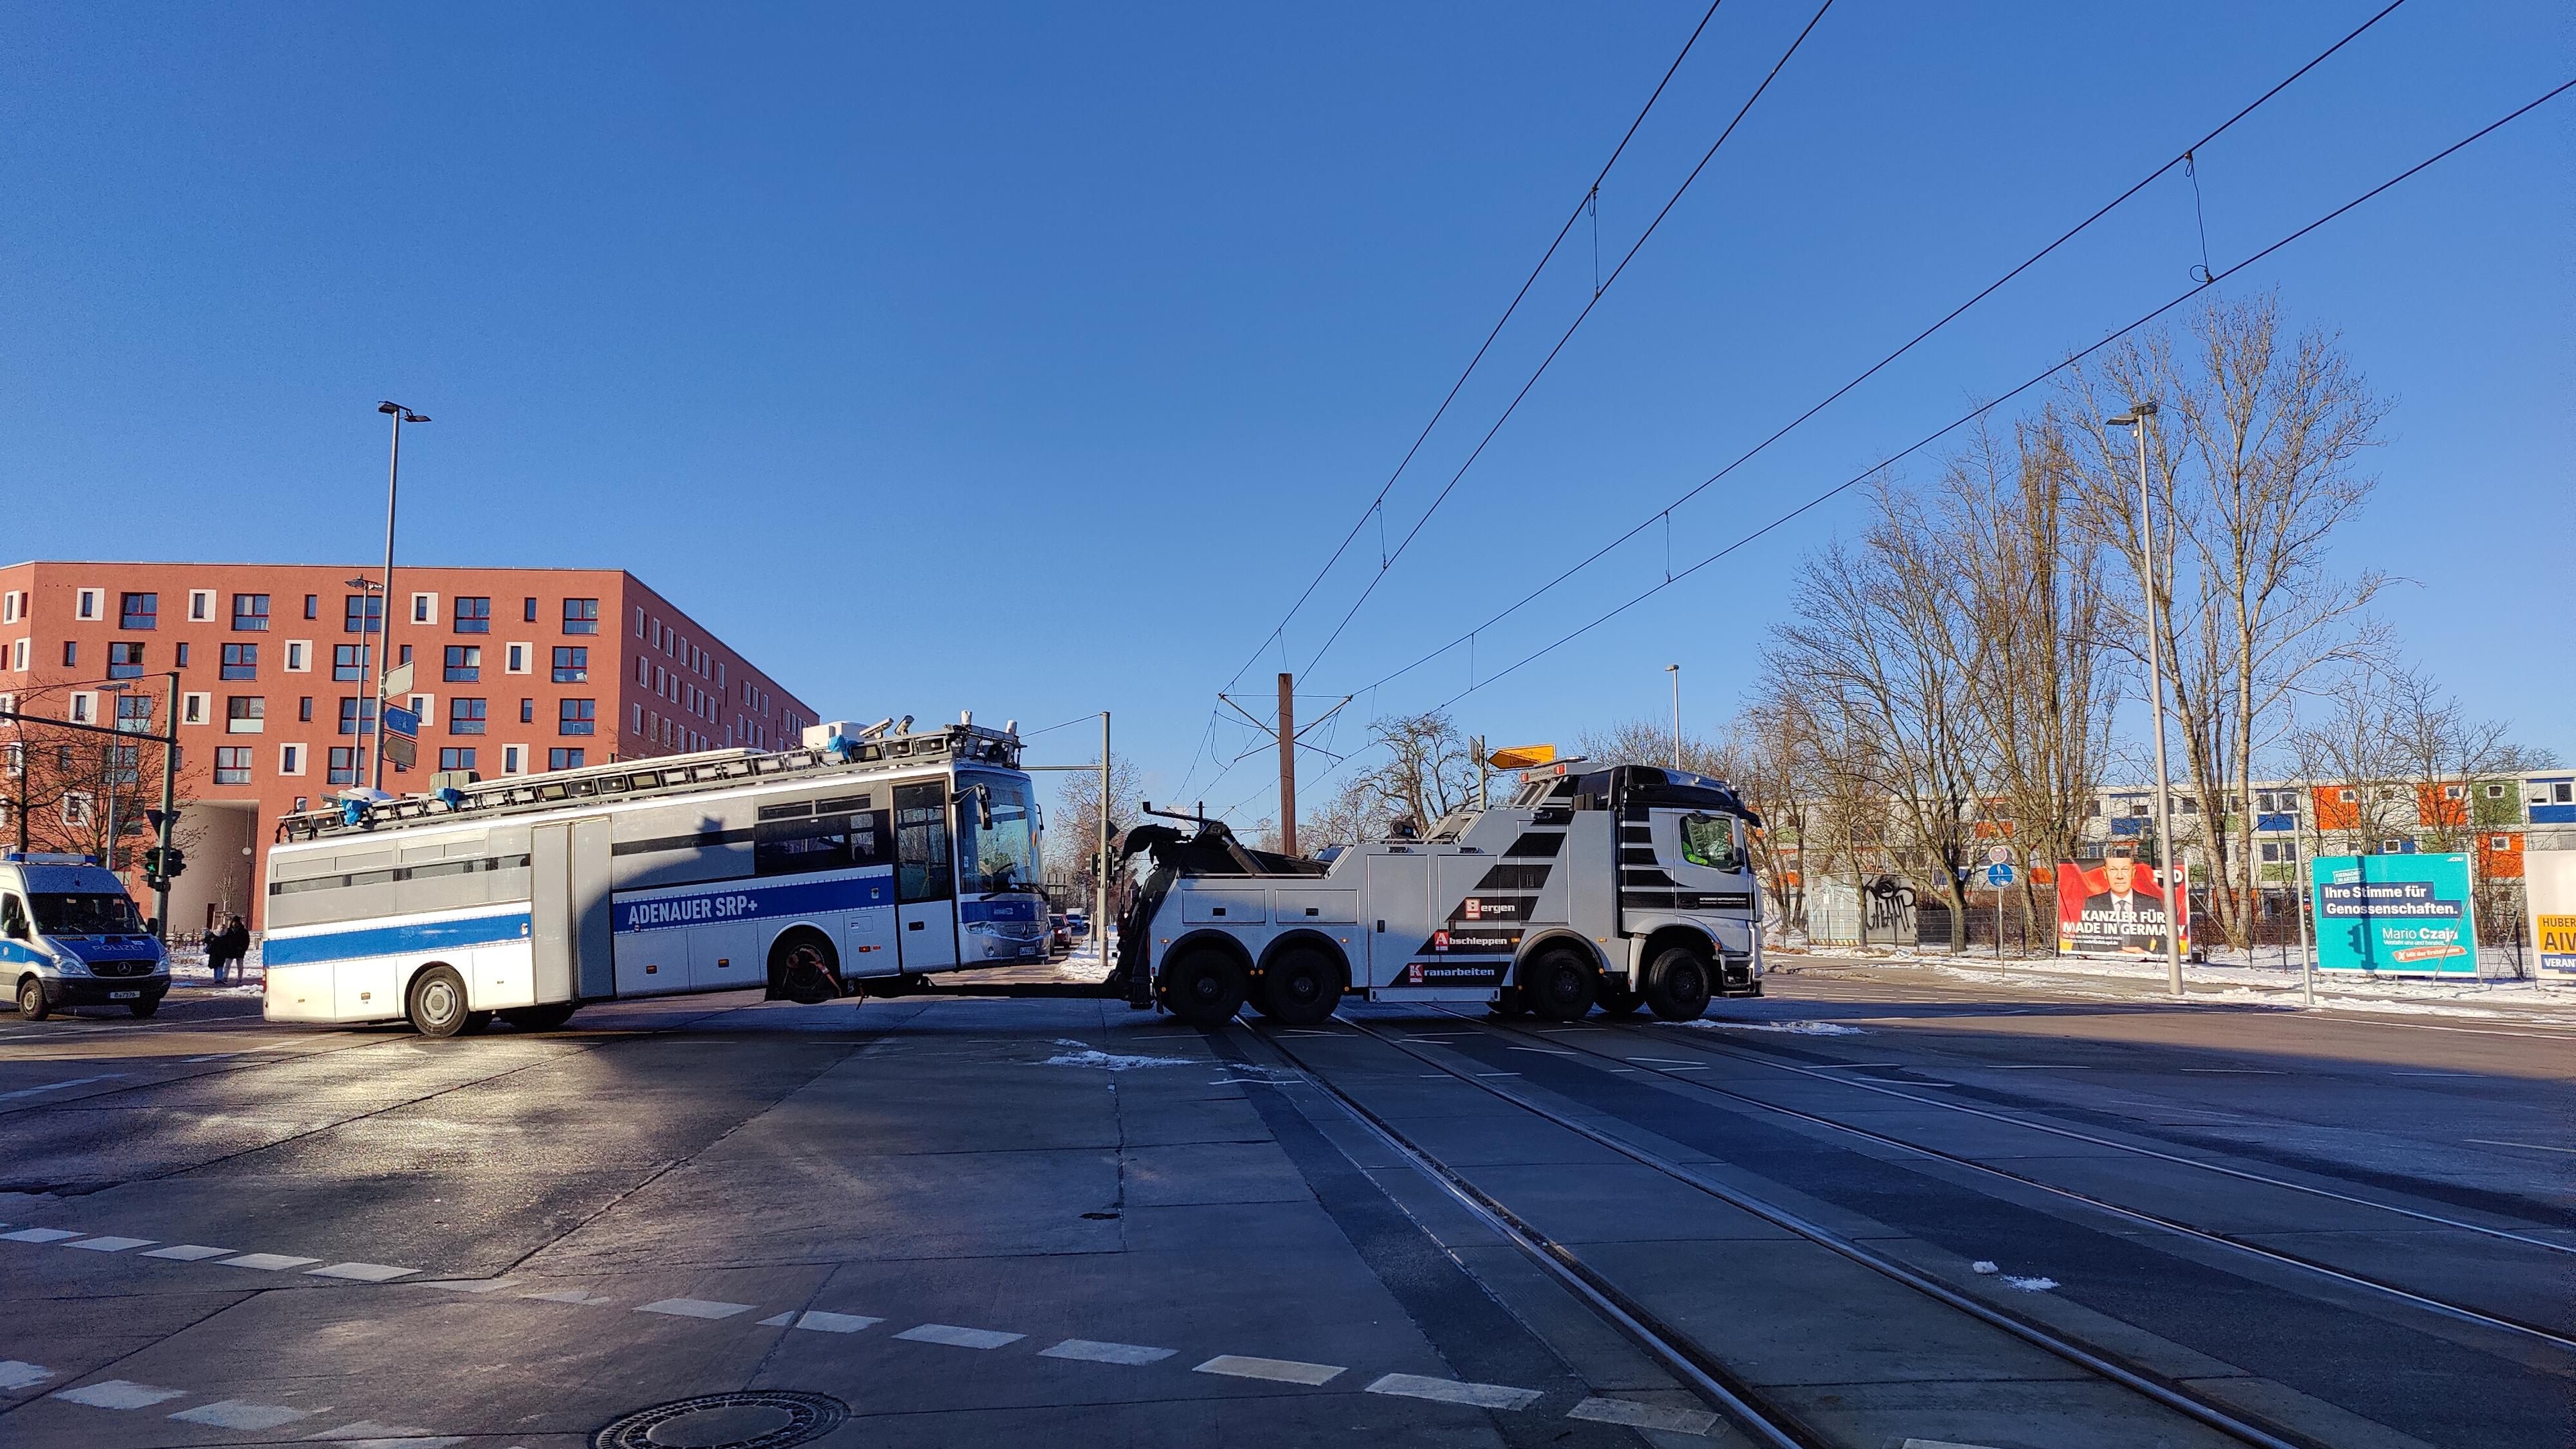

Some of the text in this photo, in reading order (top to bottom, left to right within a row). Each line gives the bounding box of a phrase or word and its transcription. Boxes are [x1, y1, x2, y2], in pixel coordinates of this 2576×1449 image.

[2153, 869, 2184, 883] SD
[2325, 885, 2426, 898] Ihre Stimme für
[628, 896, 757, 925] ADENAUER SRP+
[1466, 899, 1515, 914] Bergen
[2326, 903, 2458, 915] Genossenschaften.
[2082, 909, 2166, 923] KANZLER FÜR
[2063, 921, 2186, 936] MADE IN GERMAY
[2382, 927, 2459, 942] Mario Czaja
[1435, 932, 1507, 946] Abschleppen
[2544, 958, 2576, 967] VERAN
[1410, 965, 1495, 976] Kranarbeiten
